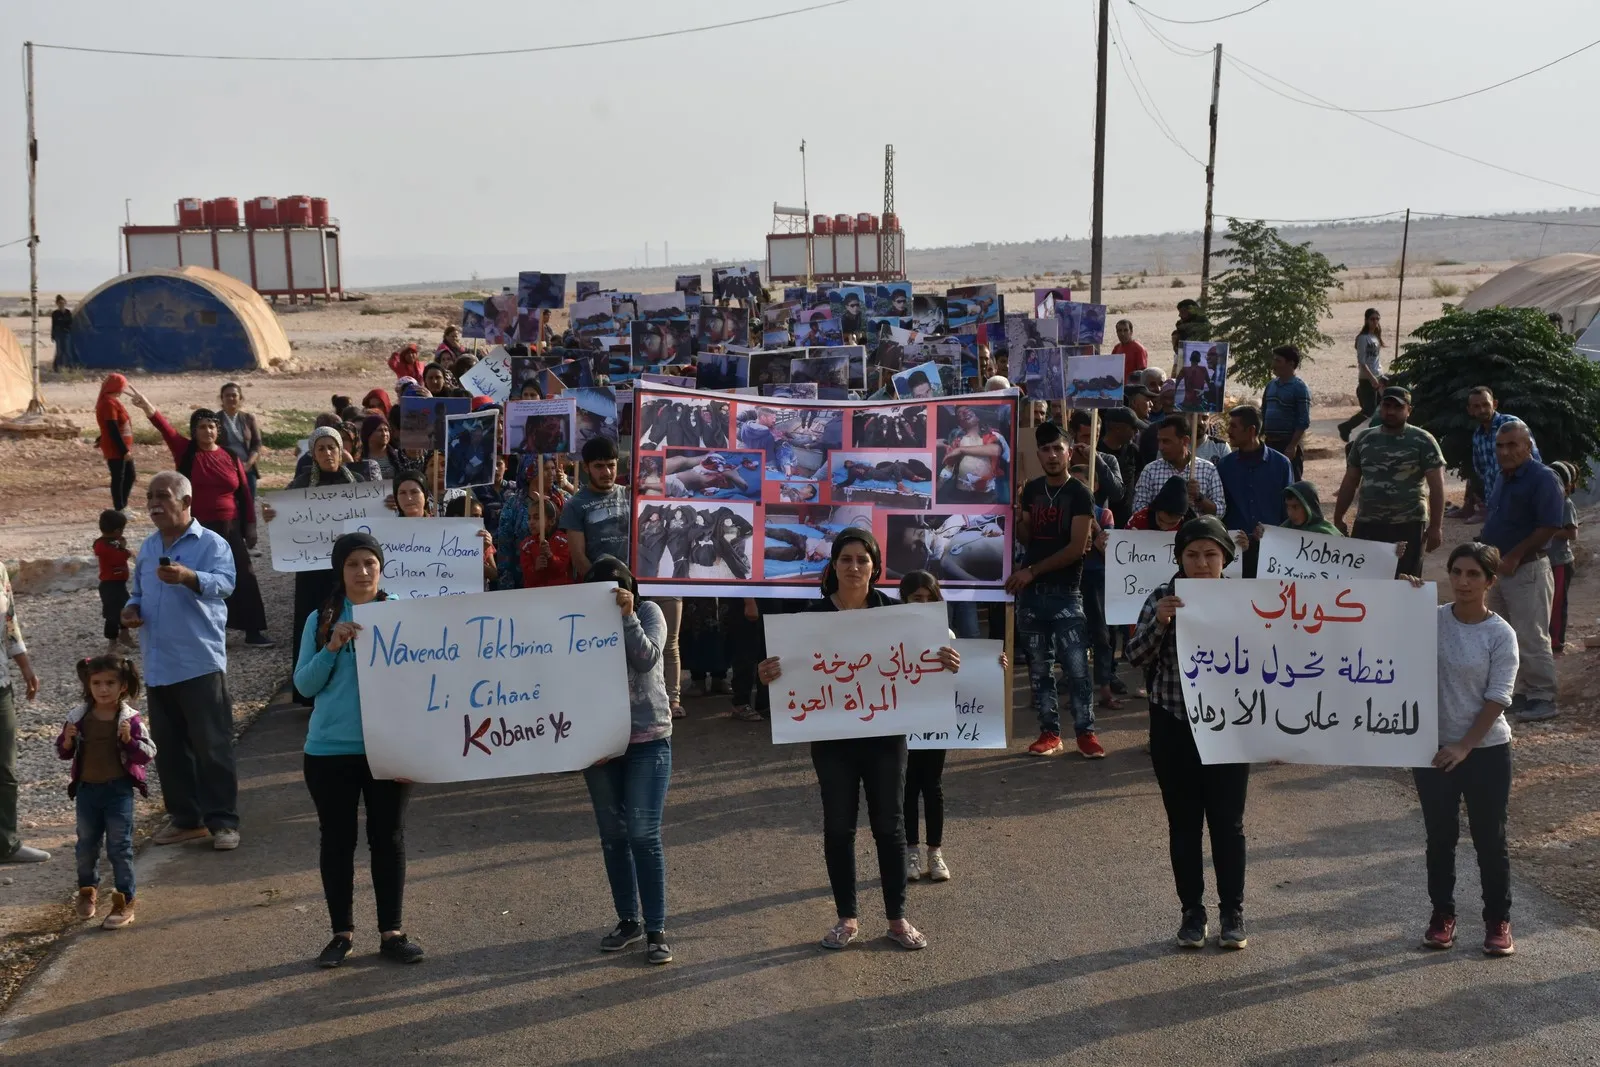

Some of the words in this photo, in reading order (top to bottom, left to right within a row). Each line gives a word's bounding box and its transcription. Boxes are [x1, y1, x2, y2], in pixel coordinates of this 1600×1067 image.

[1251, 580, 1366, 634] كوباني
[370, 620, 460, 667] Navenda
[559, 613, 619, 655] Terorê
[812, 652, 872, 683] صرخة
[878, 642, 945, 685] كوباني
[1182, 635, 1250, 688] تاريخي
[1261, 644, 1325, 688] تحول
[1338, 646, 1395, 684] نقطة
[426, 673, 450, 712] Li
[788, 684, 834, 721] الحرة
[844, 681, 897, 721] المرأة
[549, 711, 572, 743] Ye
[956, 722, 980, 741] Yek
[1275, 690, 1339, 735] على
[1352, 697, 1419, 736] للقضاء
